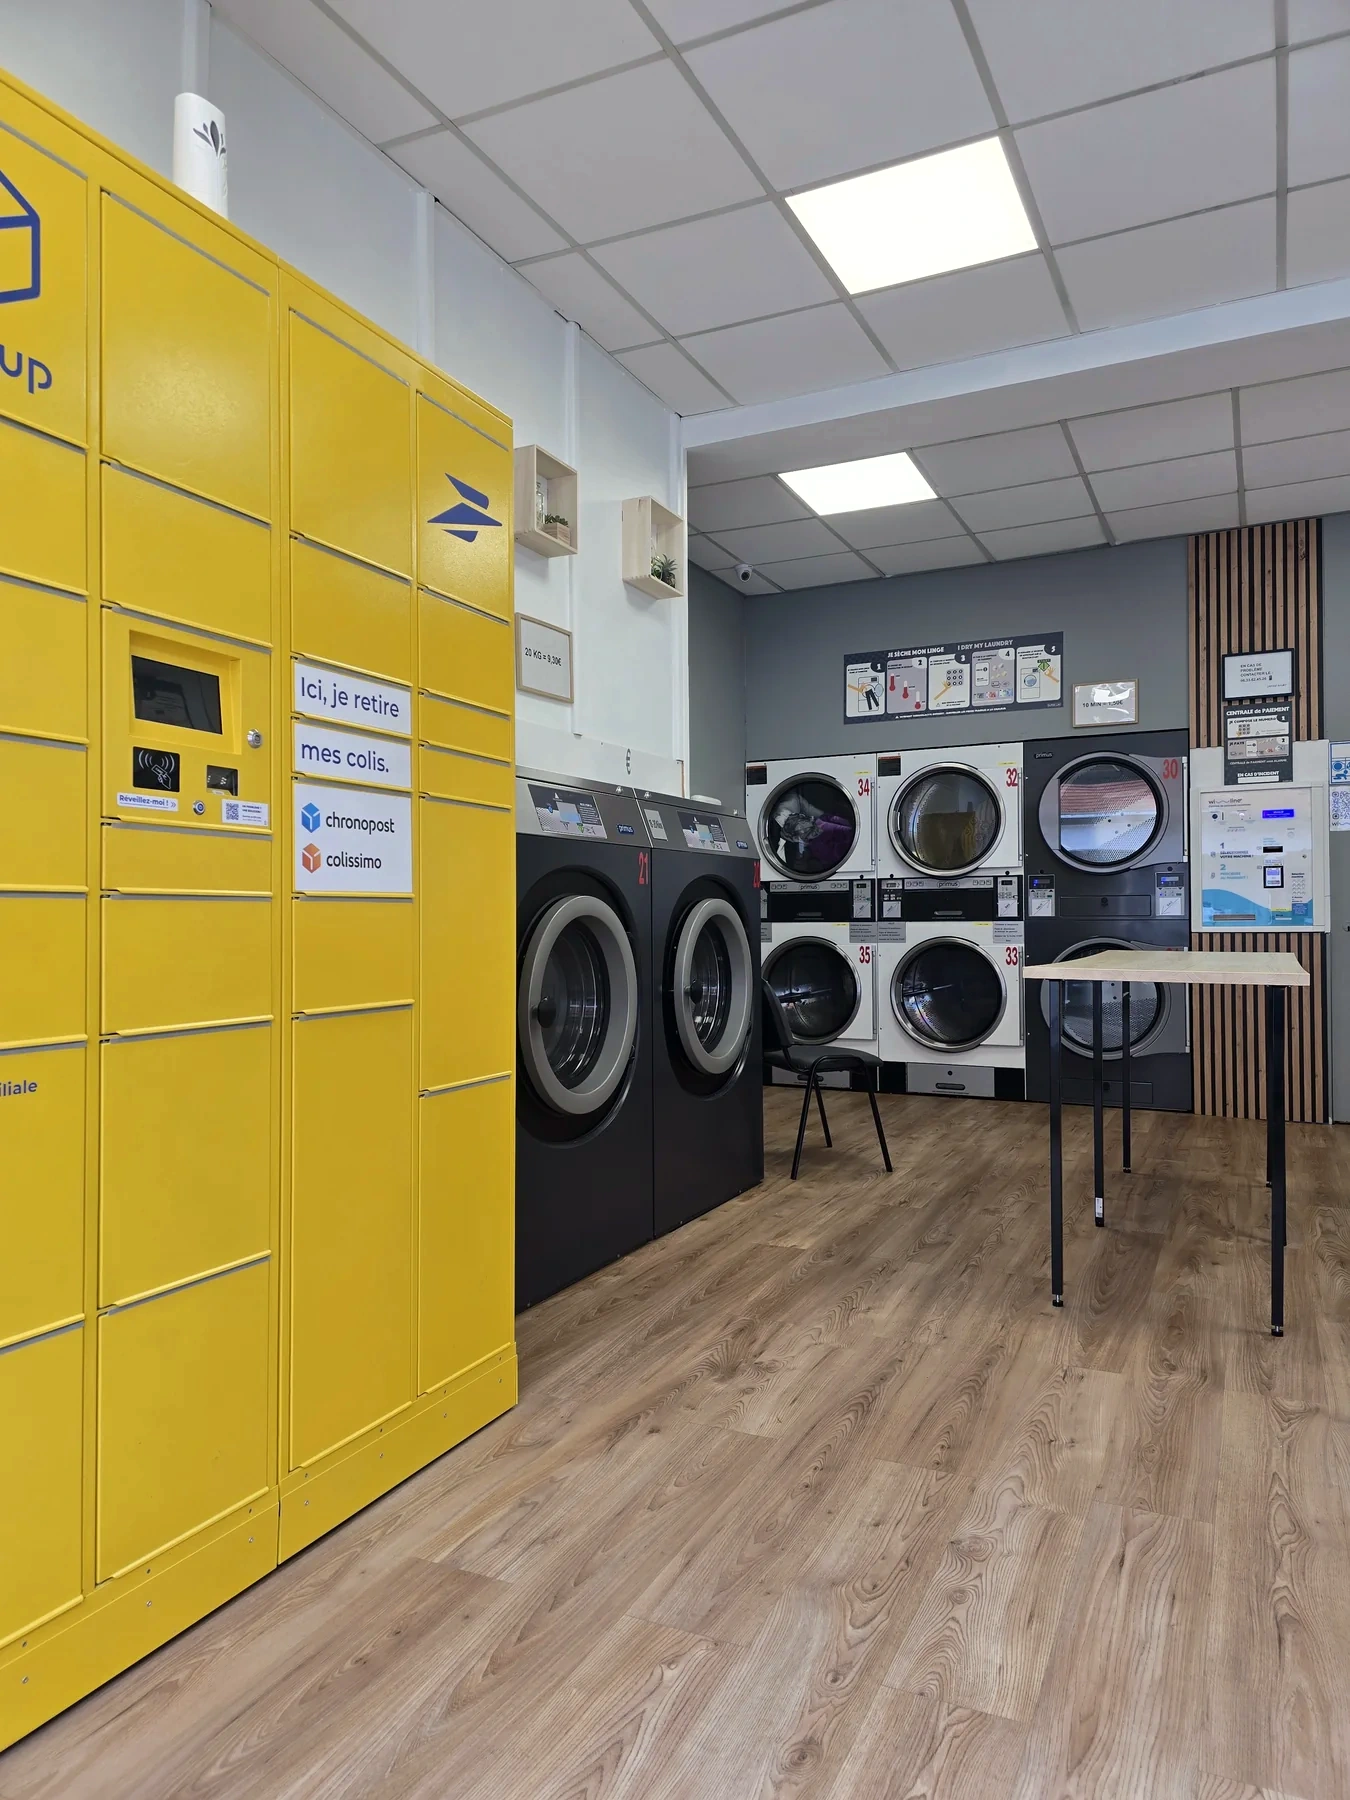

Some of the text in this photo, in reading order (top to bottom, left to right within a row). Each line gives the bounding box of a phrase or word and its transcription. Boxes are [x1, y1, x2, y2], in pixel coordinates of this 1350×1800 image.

[912, 648, 926, 656] MON
[984, 639, 1013, 648] LAUNDRY
[525, 647, 532, 657] 20
[533, 649, 542, 660] KG
[547, 654, 562, 667] 9,30€
[960, 654, 966, 662] 3
[301, 676, 399, 717] Ici, je retire
[1262, 706, 1290, 714] PAIEMENT
[301, 743, 389, 773] mes colis.
[1006, 768, 1018, 787] 32
[1163, 759, 1178, 780] 30
[858, 778, 870, 796] 34
[119, 794, 165, 806] Réveillez-moi
[325, 811, 395, 835] chronopost
[326, 851, 382, 869] colissimo
[638, 851, 649, 885] 21
[859, 945, 871, 964] 35
[1005, 946, 1018, 966] 33
